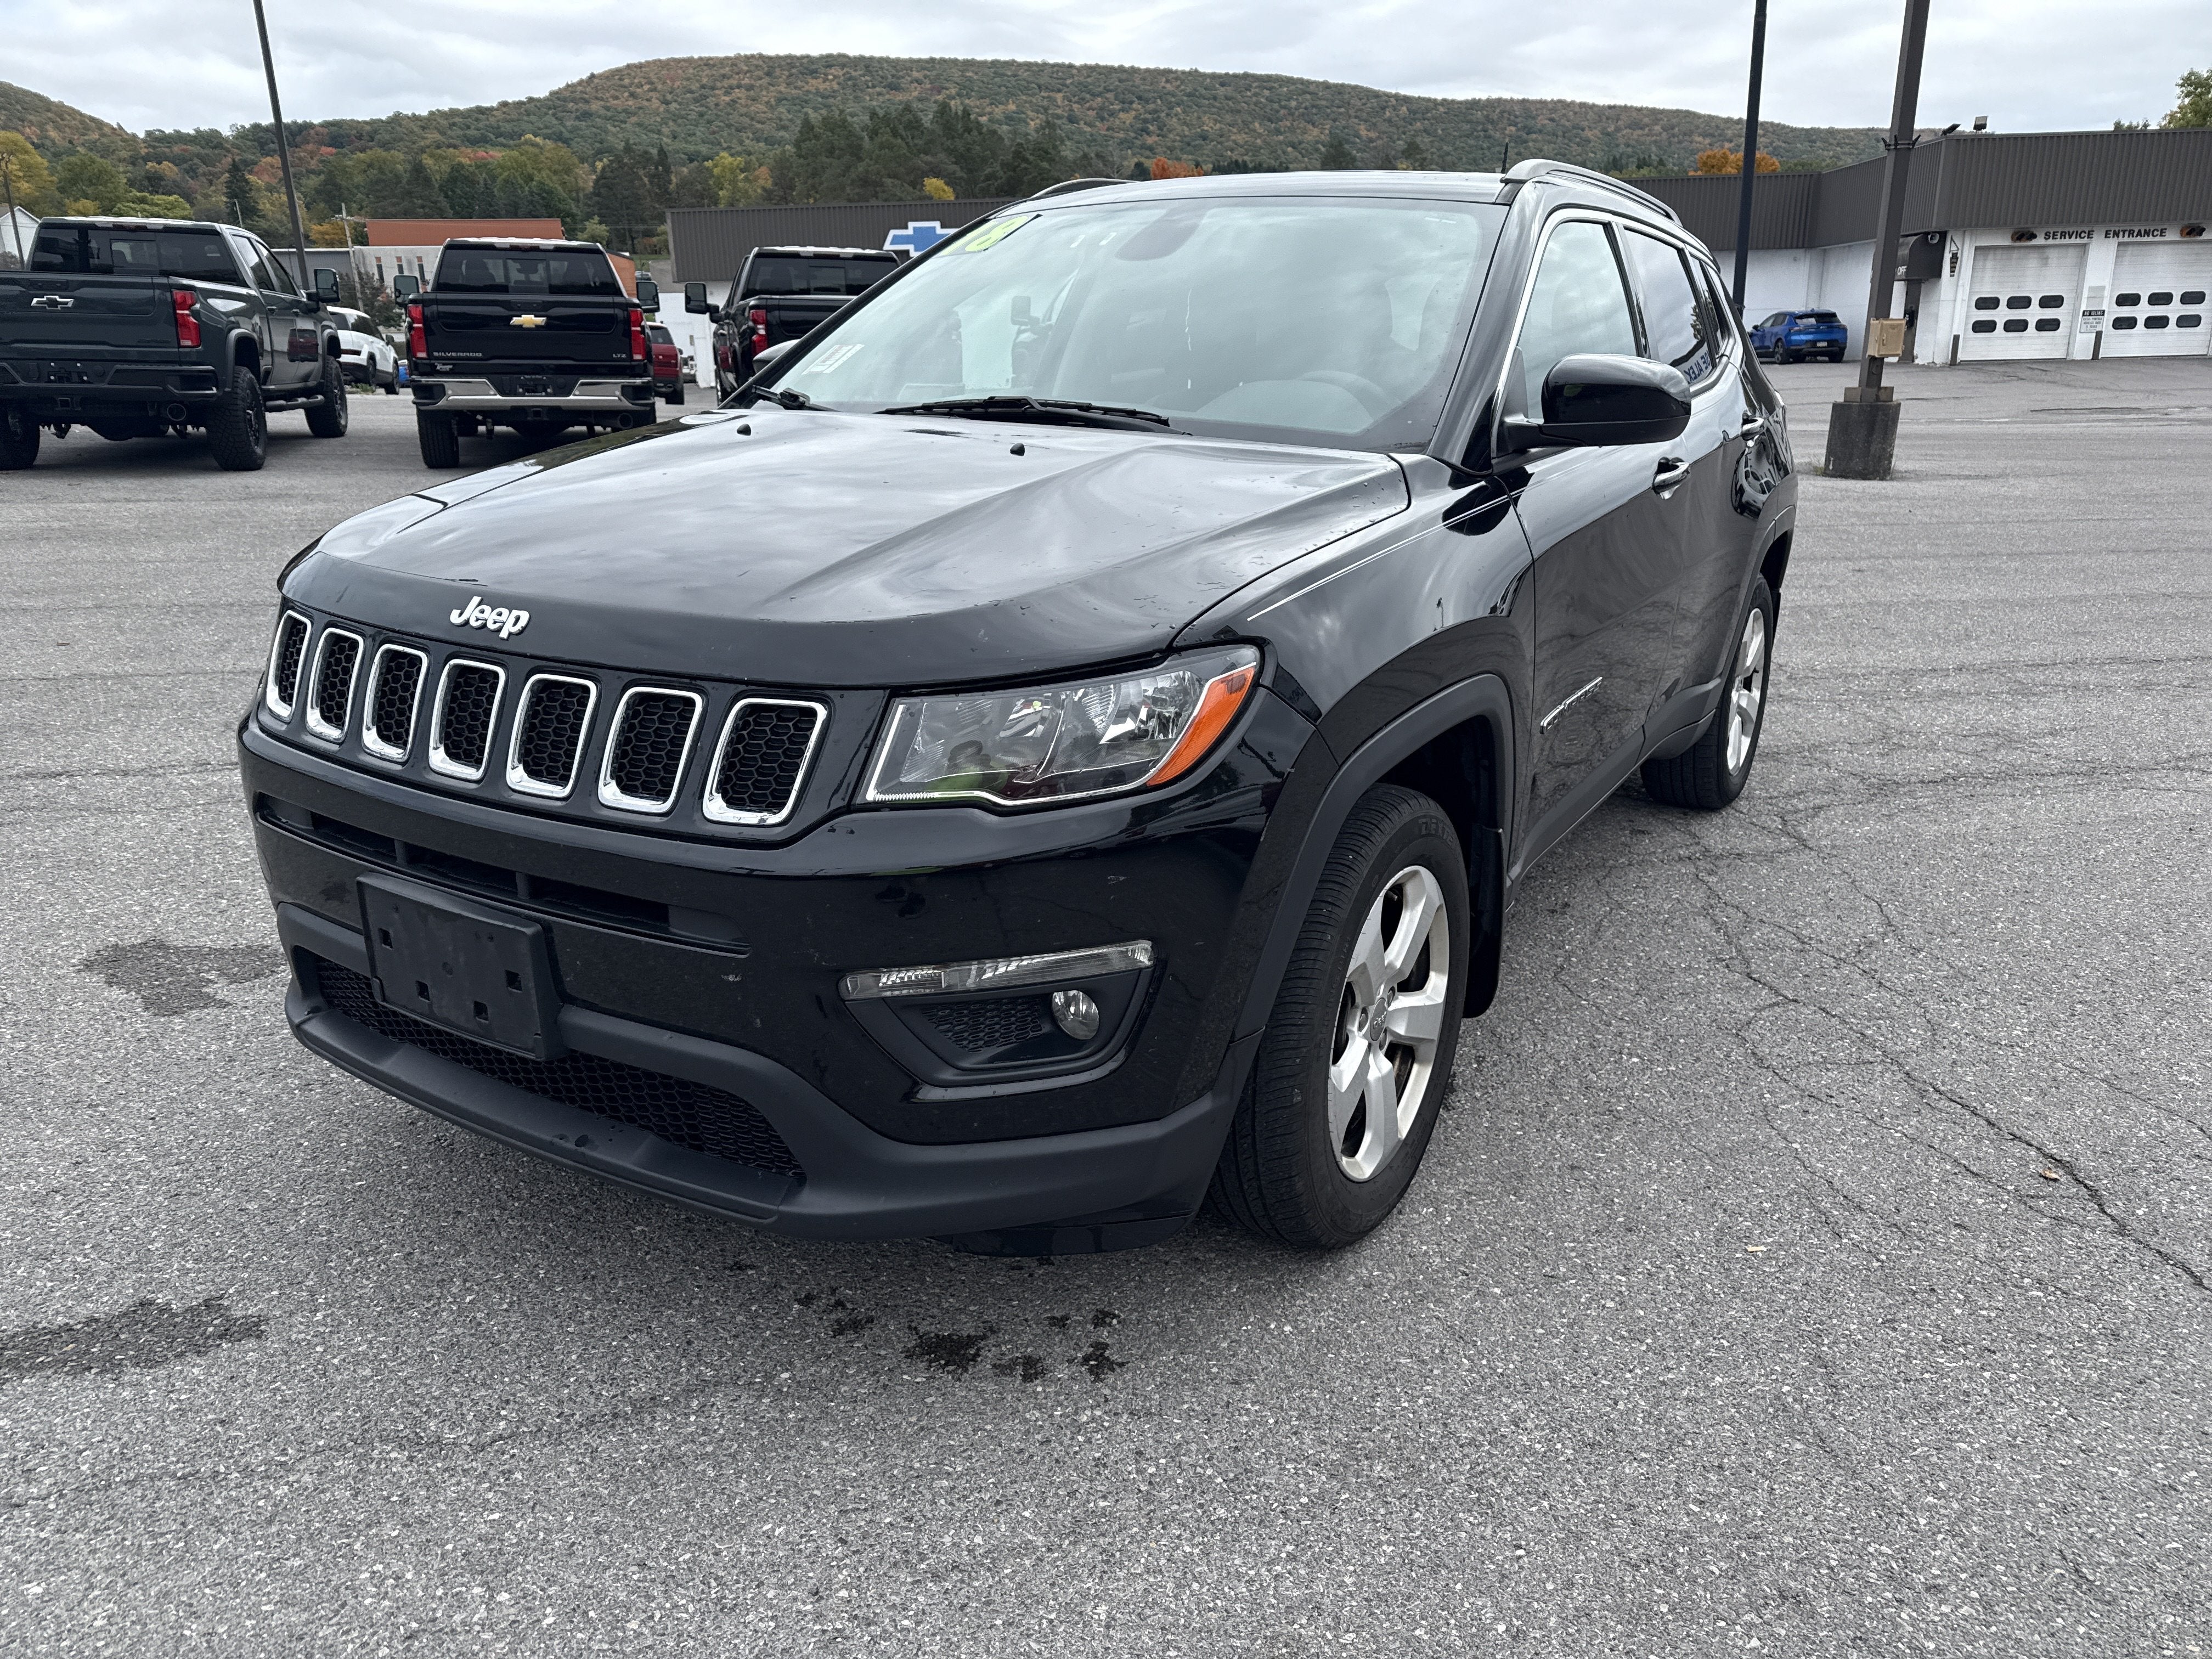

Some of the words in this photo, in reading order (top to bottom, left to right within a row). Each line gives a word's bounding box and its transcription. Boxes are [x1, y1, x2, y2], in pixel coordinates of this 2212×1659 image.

[939, 216, 1029, 255] 18
[2044, 230, 2095, 240] SERVICE
[2104, 228, 2168, 239] ENTRANCE
[1897, 266, 1907, 275] OFF
[449, 596, 531, 641] Jeep
